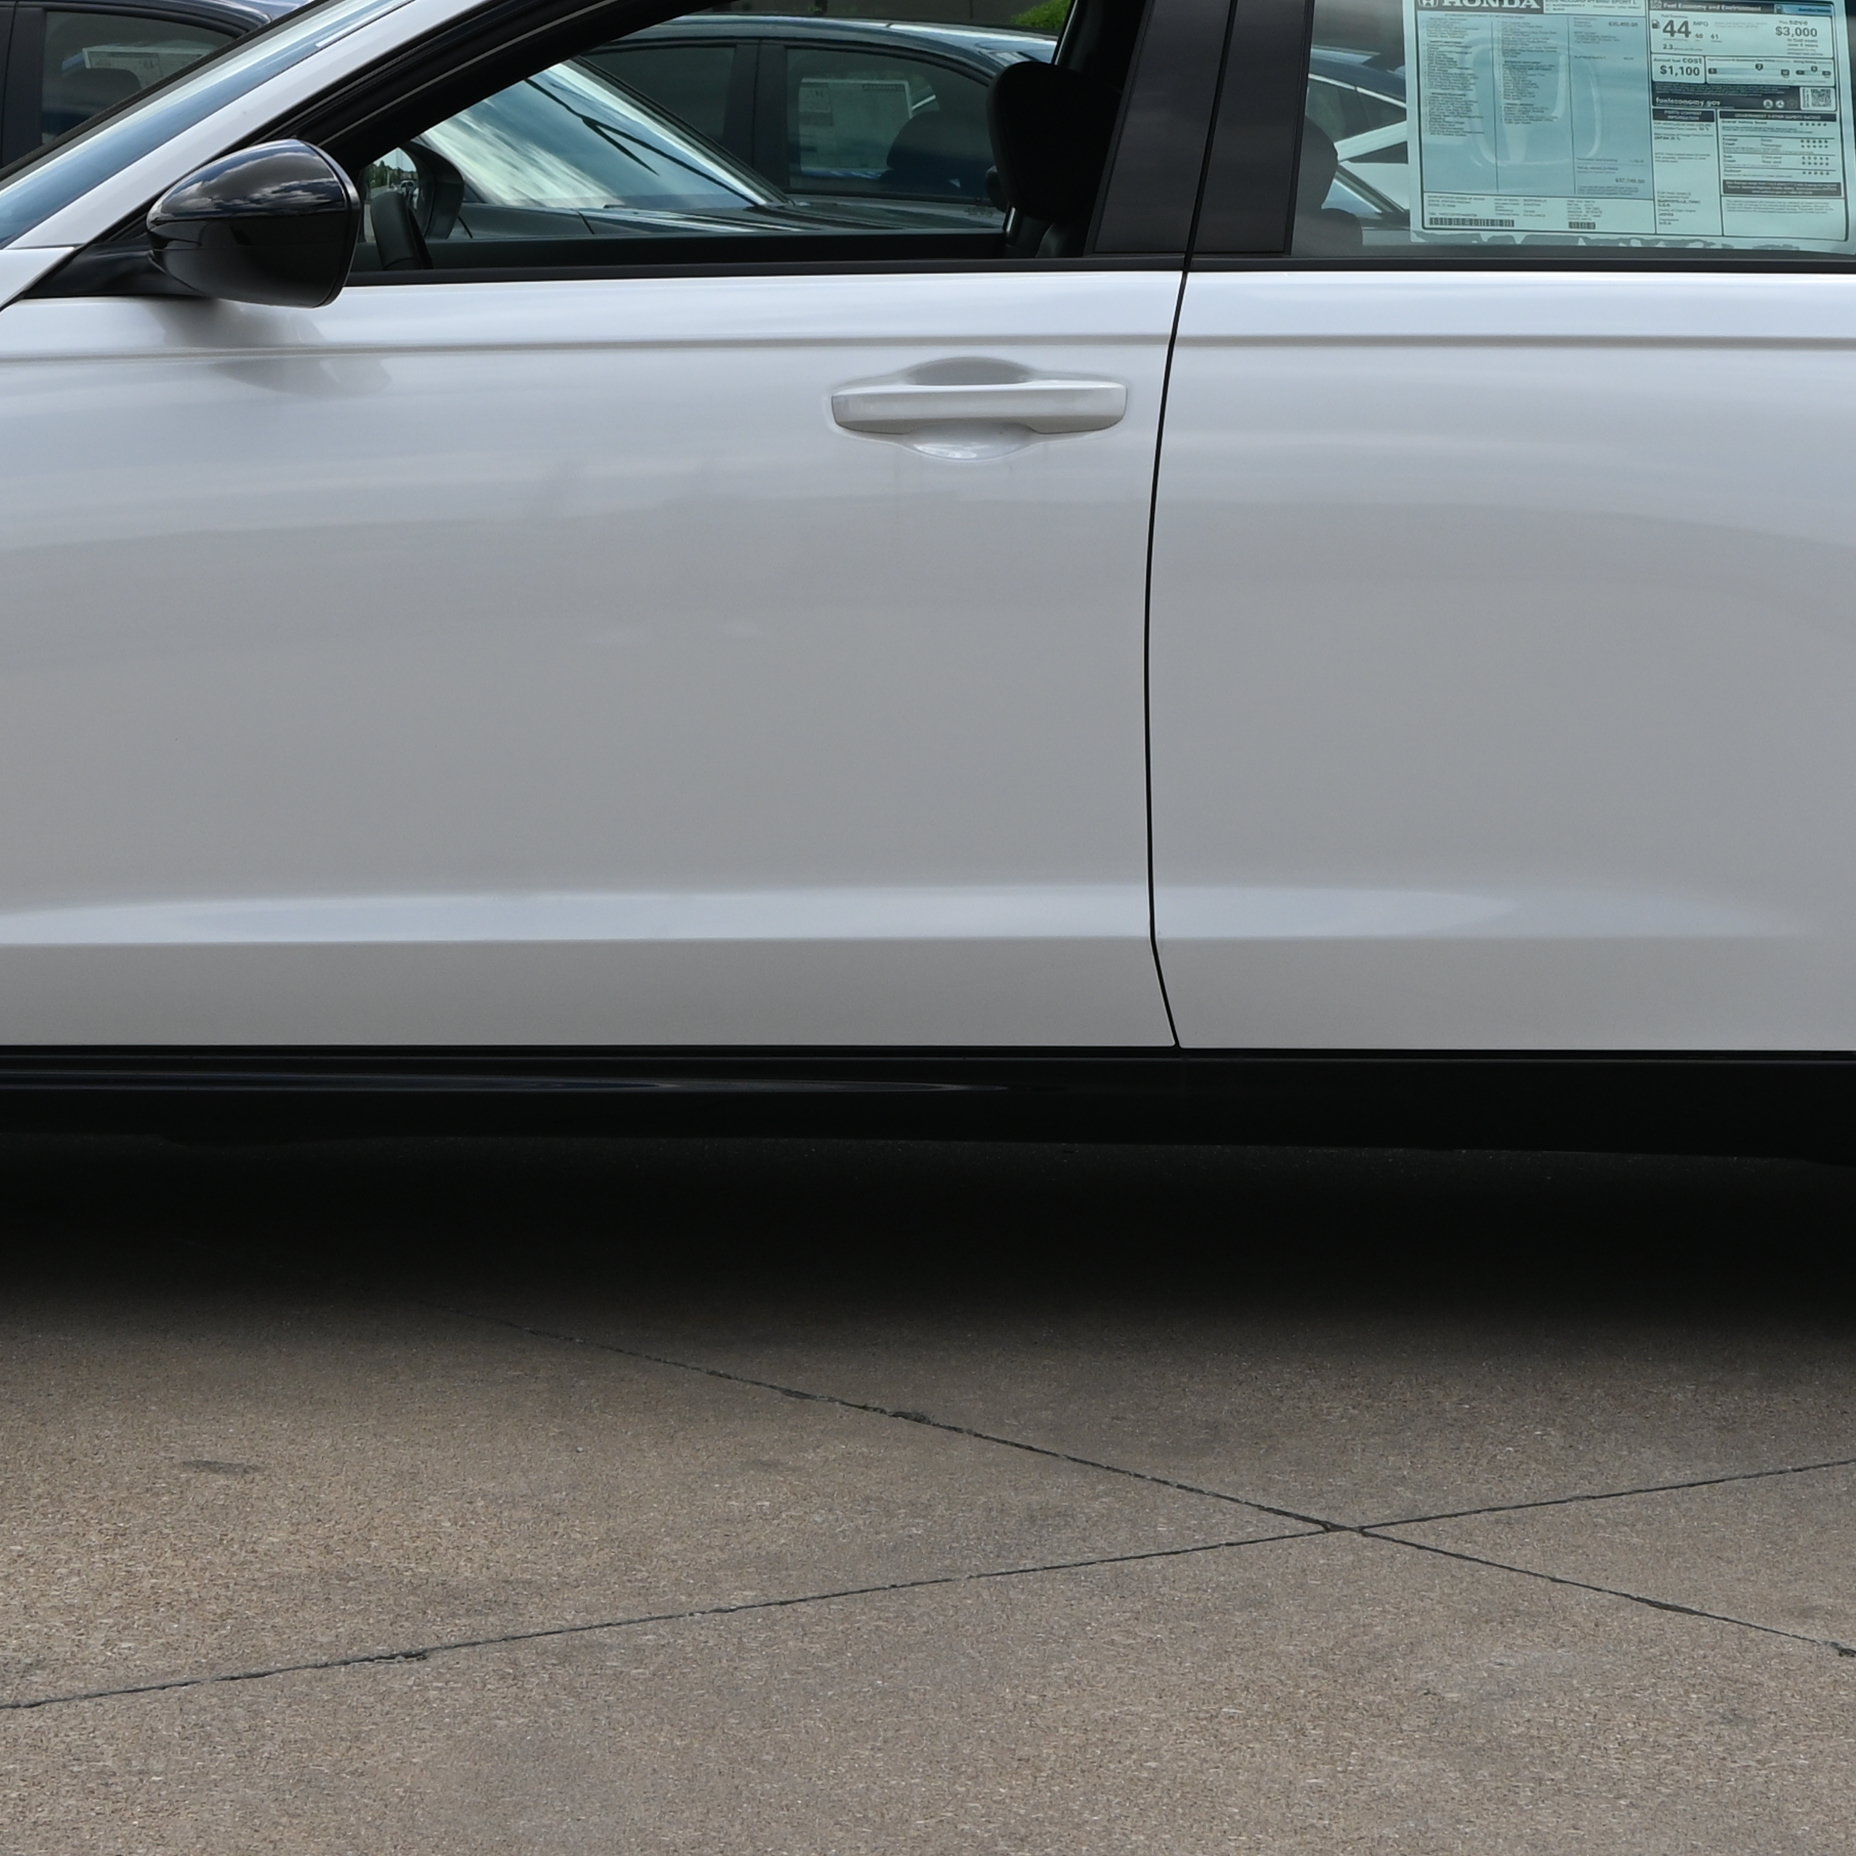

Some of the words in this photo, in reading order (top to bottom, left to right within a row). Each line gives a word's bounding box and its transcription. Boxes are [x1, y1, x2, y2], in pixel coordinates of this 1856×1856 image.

[1662, 19, 1692, 38] 44
[1775, 26, 1818, 38] $3,000
[1659, 65, 1701, 77] $1,100
